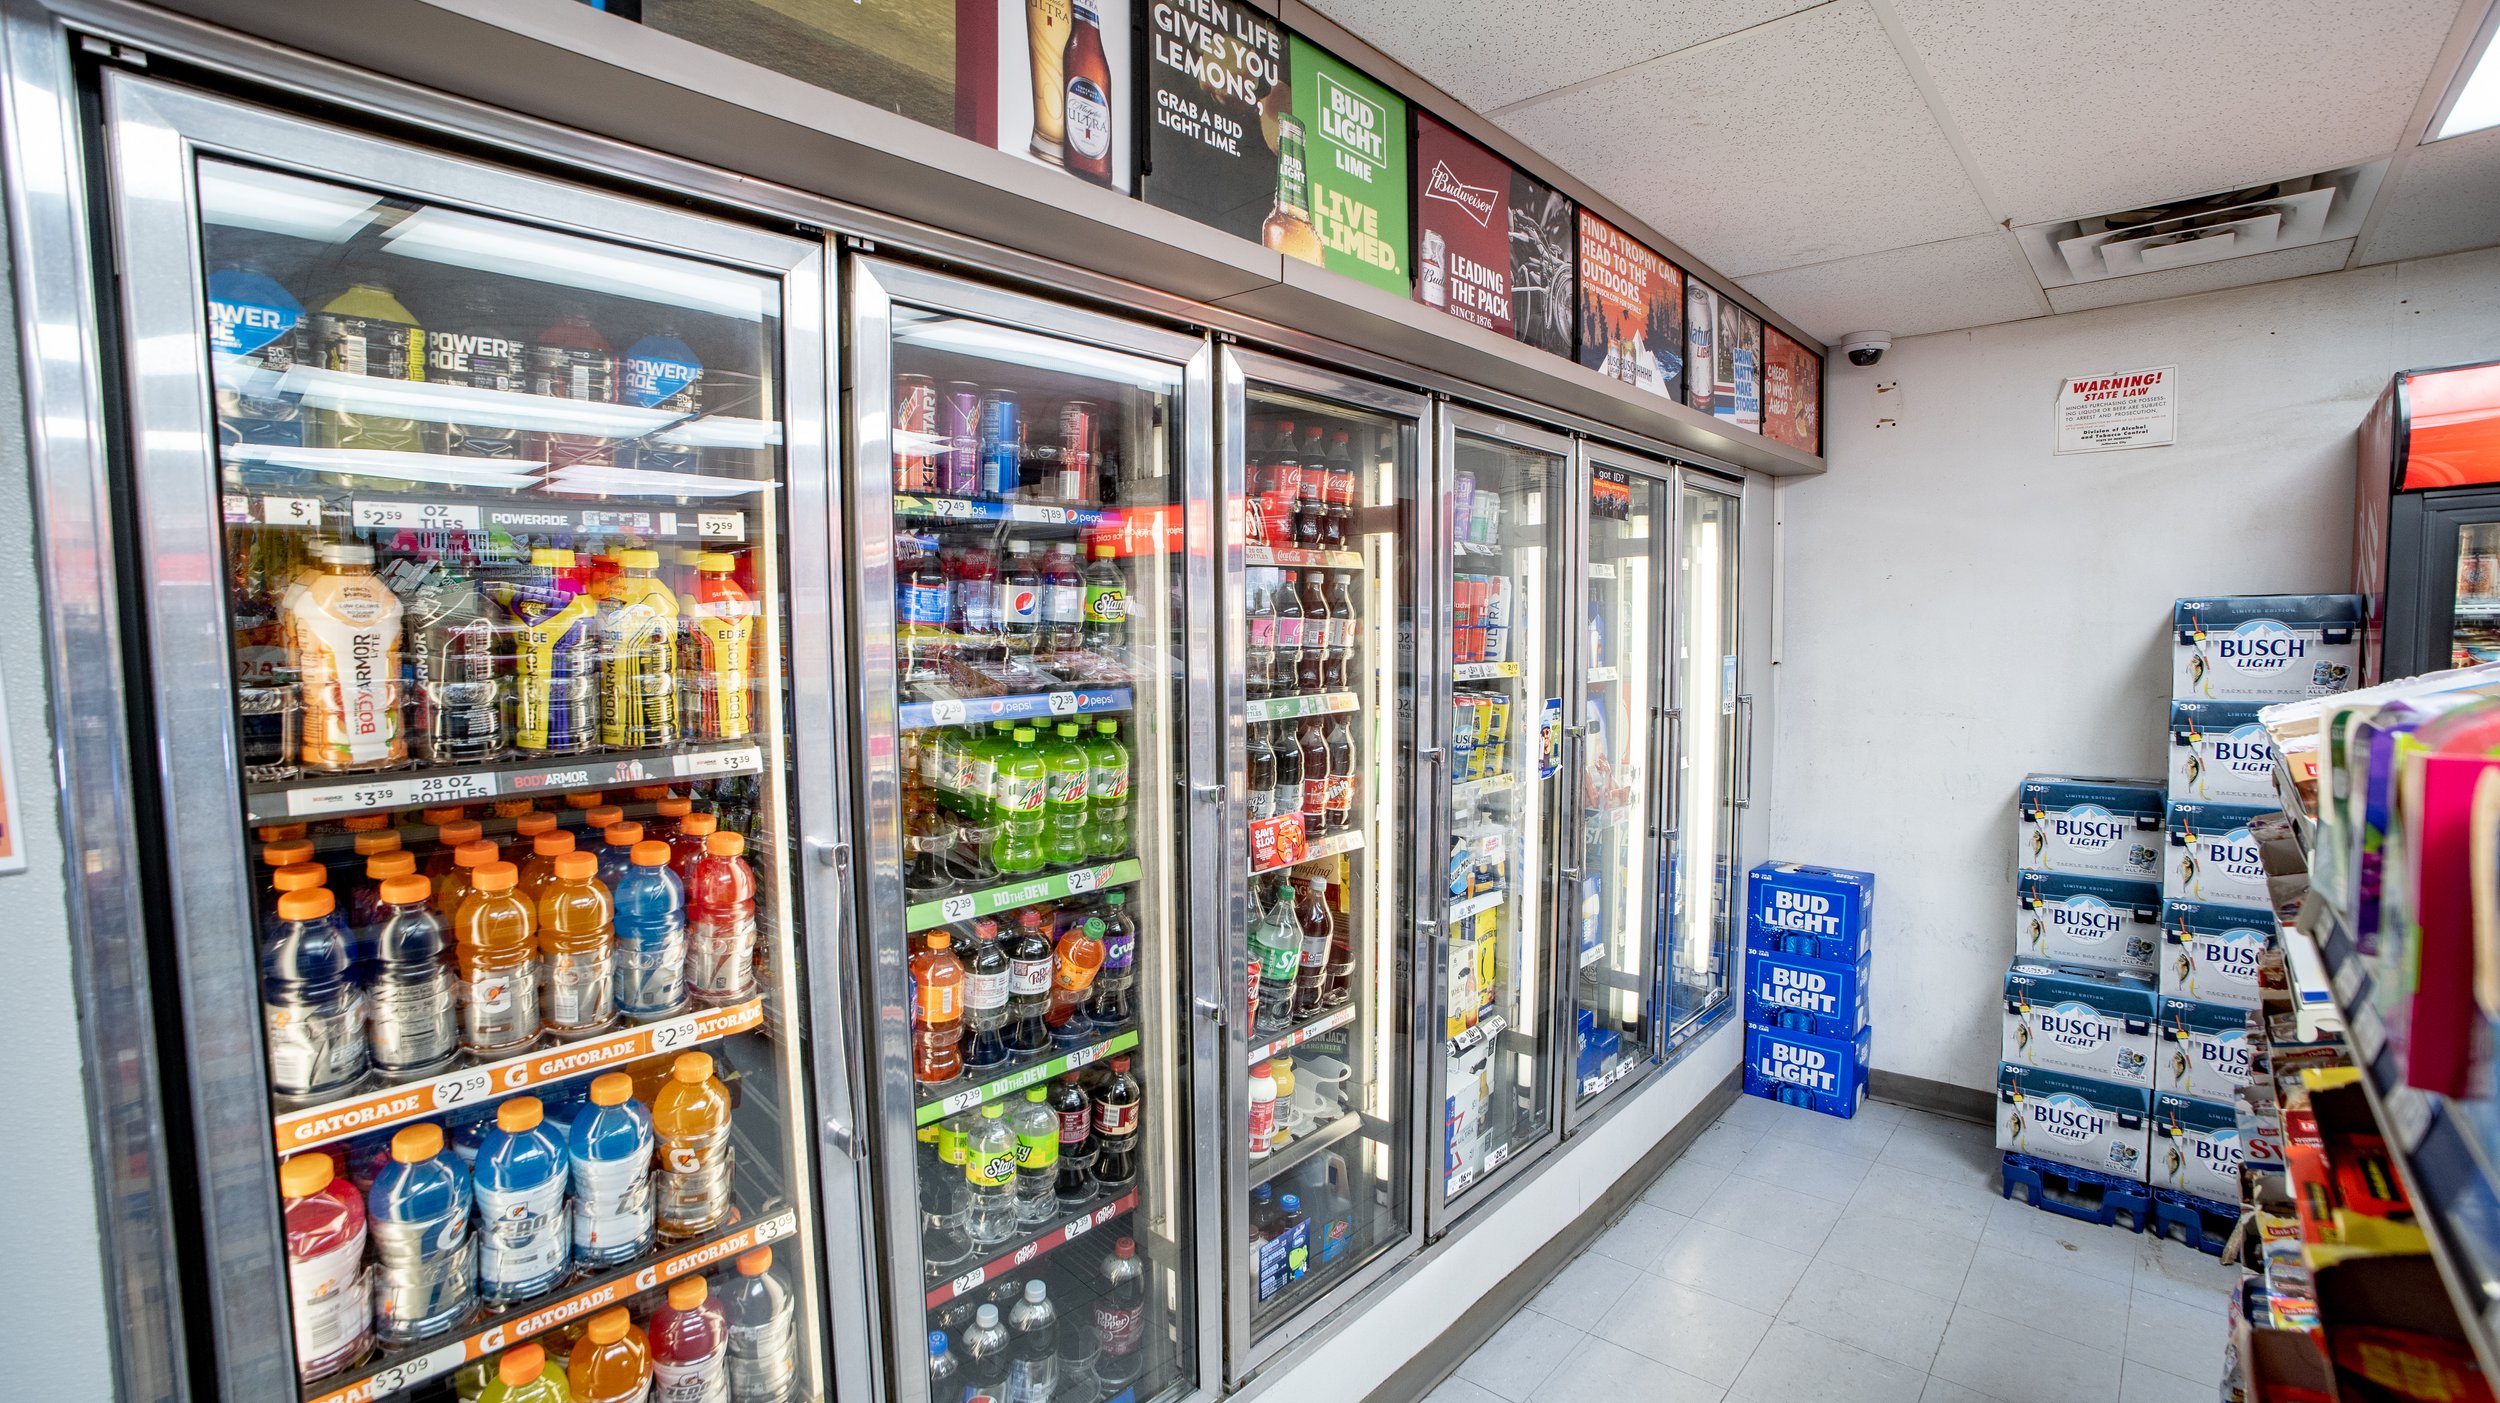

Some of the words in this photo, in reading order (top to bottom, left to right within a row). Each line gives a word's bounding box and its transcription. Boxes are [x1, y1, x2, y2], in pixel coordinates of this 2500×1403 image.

[1154, 4, 1226, 59] GIVES
[1231, 41, 1278, 86] YOU
[1236, 14, 1279, 59] LIFE
[1156, 34, 1264, 116] LEMONS,
[1157, 90, 1198, 119] GRAB
[1201, 110, 1211, 126] A
[1215, 114, 1243, 138] BUD
[1331, 87, 1374, 130] BUD
[1068, 108, 1107, 133] ULTRA
[1158, 108, 1200, 139] LIGHT
[1205, 128, 1241, 157] LIME.
[1323, 107, 1382, 159] LIGHT
[1280, 164, 1305, 184] LIGHT
[1284, 156, 1302, 171] BUD
[1336, 149, 1372, 184] LIME
[1432, 168, 1492, 213] Budweiser
[1315, 183, 1377, 237] LIVE
[1315, 214, 1400, 275] LIMED.
[1582, 213, 1606, 243] FIND
[1609, 232, 1617, 250] A
[1619, 237, 1656, 273] TROPHY
[1659, 259, 1679, 288] CAN.
[1582, 236, 1610, 266] HEAD
[1613, 252, 1626, 275] TO
[1629, 262, 1647, 288] THE
[1451, 253, 1503, 295] LEADING
[1582, 259, 1642, 304] OUTDOORS.
[1451, 278, 1475, 307] THE
[1478, 288, 1510, 321] PACK.
[1451, 304, 1475, 323] SINCE
[1477, 315, 1493, 329] 1876.
[429, 332, 508, 357] POWER
[429, 350, 468, 372] ADE
[1735, 349, 1753, 365] DRINK
[627, 359, 687, 380] POWER
[1735, 366, 1755, 381] NATTY
[1768, 365, 1788, 382] CHEERS
[626, 373, 657, 391] ADE
[1735, 381, 1752, 395] MAKE
[1765, 379, 1771, 393] TO
[1772, 382, 1793, 401] WHAT'S
[2073, 372, 2162, 394] WARNING!
[2084, 391, 2118, 401] STATE
[2123, 387, 2148, 398] LAW
[2090, 400, 2126, 408] PURCHASING
[1770, 398, 1788, 415] AHEAD
[1600, 471, 1611, 480] got
[1614, 473, 1624, 482] ID?
[424, 505, 448, 516] OZ
[492, 513, 568, 526] POWERADE
[1080, 514, 1104, 525] pepsi
[1278, 550, 1301, 561] Coca-Cola
[719, 629, 746, 639] EDGE
[1487, 601, 1501, 648] ULTRA
[371, 634, 380, 658] LYTE
[518, 631, 548, 642] EDGE
[2220, 639, 2305, 658] BUSCH
[2237, 659, 2286, 668] LIGHT
[354, 634, 376, 734] BODYARMOR
[1005, 700, 1032, 714] pepsi
[1090, 694, 1114, 708] pepsi
[422, 778, 444, 790] 28
[448, 776, 473, 788] OZ
[514, 770, 588, 789] BODYARMOR
[411, 787, 488, 803] BOTTLES
[1255, 827, 1274, 840] SAVE
[2056, 820, 2122, 840] BUSCH
[2070, 838, 2108, 847] LIGHT
[1776, 890, 1830, 915] BUD
[2171, 903, 2188, 911] 30
[1765, 908, 1839, 935] LIGHT
[2054, 909, 2120, 932] BUSCH
[2067, 927, 2106, 938] LIGHT
[1773, 967, 1826, 992] BUD
[1762, 984, 1835, 1013] LIGHT
[2167, 1000, 2184, 1008] 30
[1328, 1031, 1347, 1044] JACK
[2041, 1015, 2111, 1042] BUSCH
[539, 1040, 635, 1076] GATORADE
[696, 1004, 761, 1034] ATORADE
[2056, 1034, 2096, 1048] LIGHT
[1773, 1043, 1825, 1069] BUD
[1761, 1060, 1835, 1091] LIGHT
[2005, 1066, 2019, 1074] 30
[2162, 1096, 2178, 1106] 30
[294, 1094, 420, 1140] GATORADE
[2034, 1105, 2103, 1135] BUSCH
[2048, 1125, 2089, 1140] LIGHT
[515, 1287, 615, 1336] GATORADE
[665, 1235, 748, 1276] GATORADE
